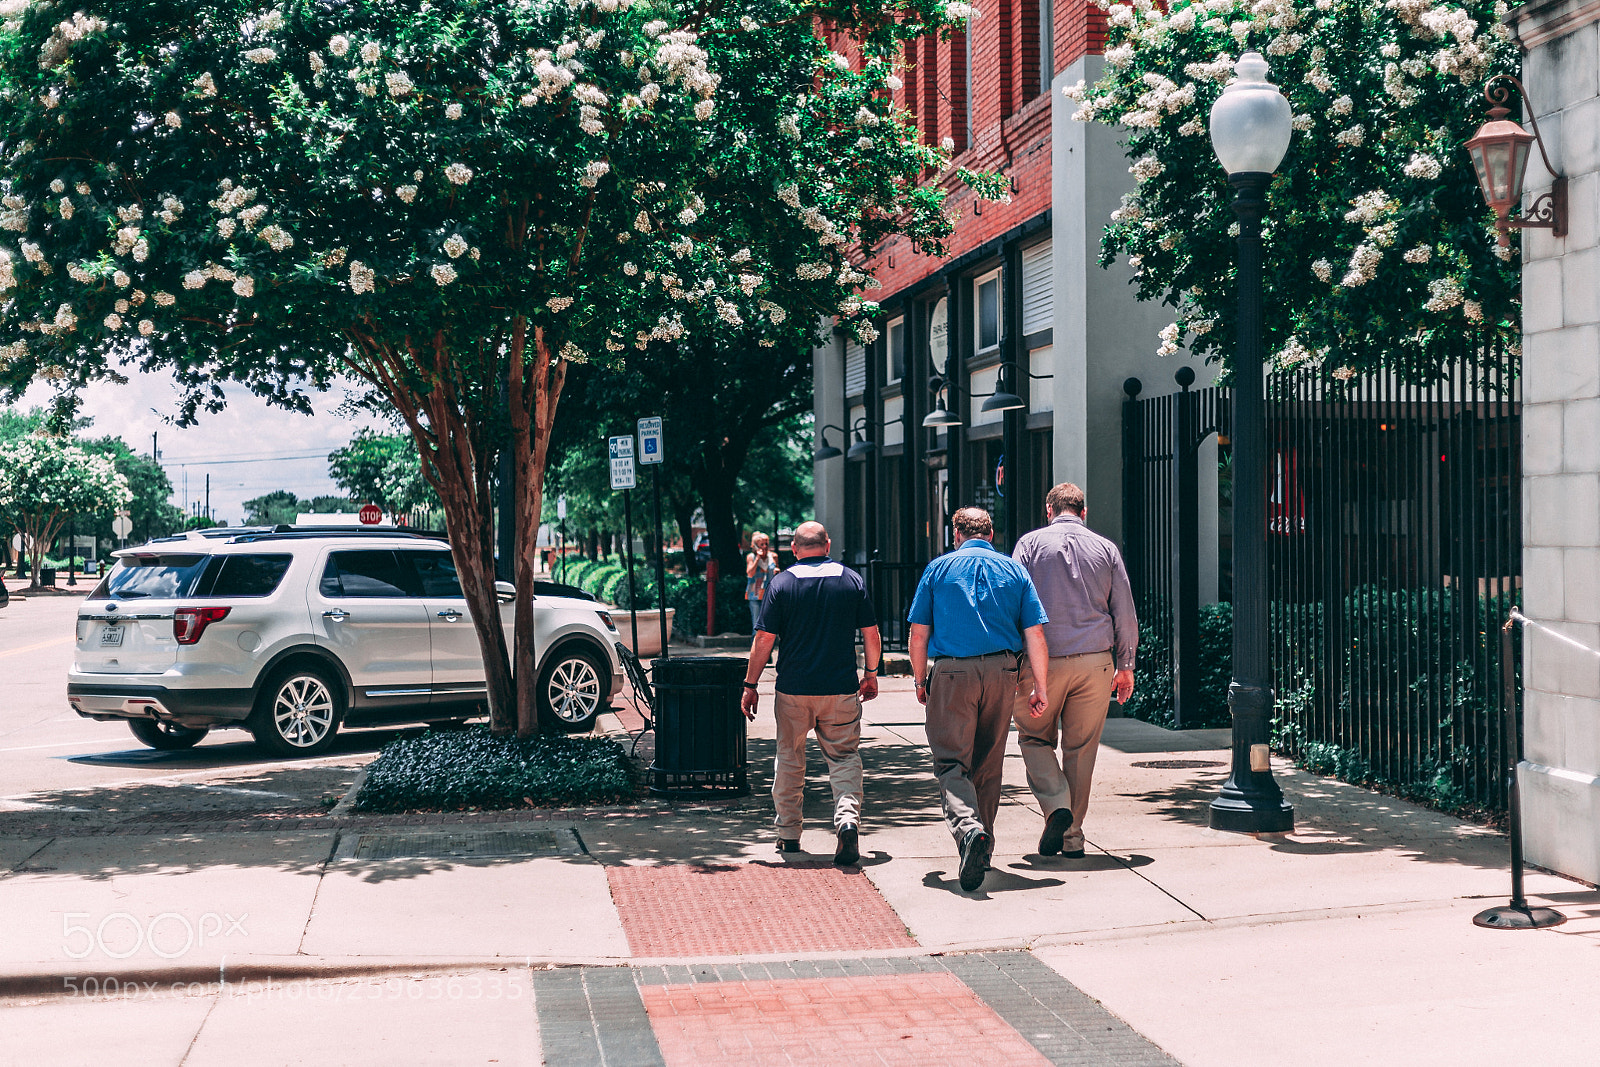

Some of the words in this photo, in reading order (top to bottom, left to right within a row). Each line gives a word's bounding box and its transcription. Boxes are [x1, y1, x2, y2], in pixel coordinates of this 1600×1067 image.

[639, 421, 660, 429] RESERVED
[641, 429, 659, 437] PARKING
[610, 443, 617, 453] 90
[361, 511, 380, 521] STOP
